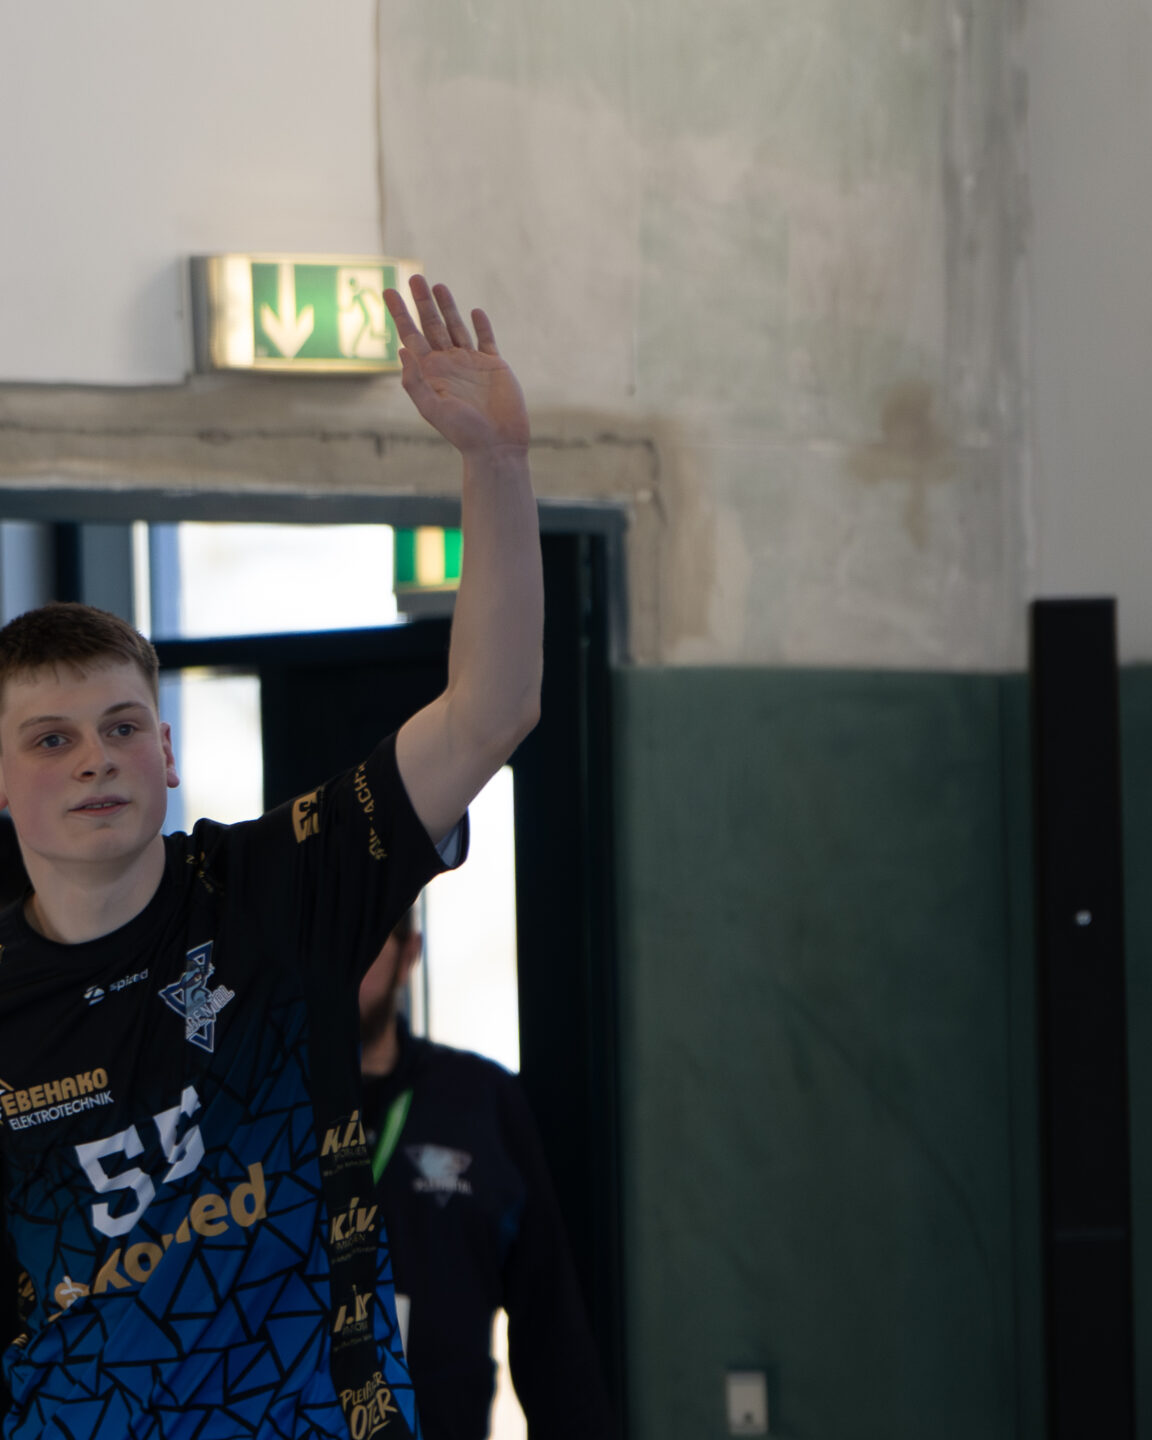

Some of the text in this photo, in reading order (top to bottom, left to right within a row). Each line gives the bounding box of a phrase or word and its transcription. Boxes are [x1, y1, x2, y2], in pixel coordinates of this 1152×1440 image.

[1, 1067, 109, 1117] EBEHAKO
[8, 1090, 114, 1131] ELEKTROTECHNIK
[92, 1161, 267, 1294] koed
